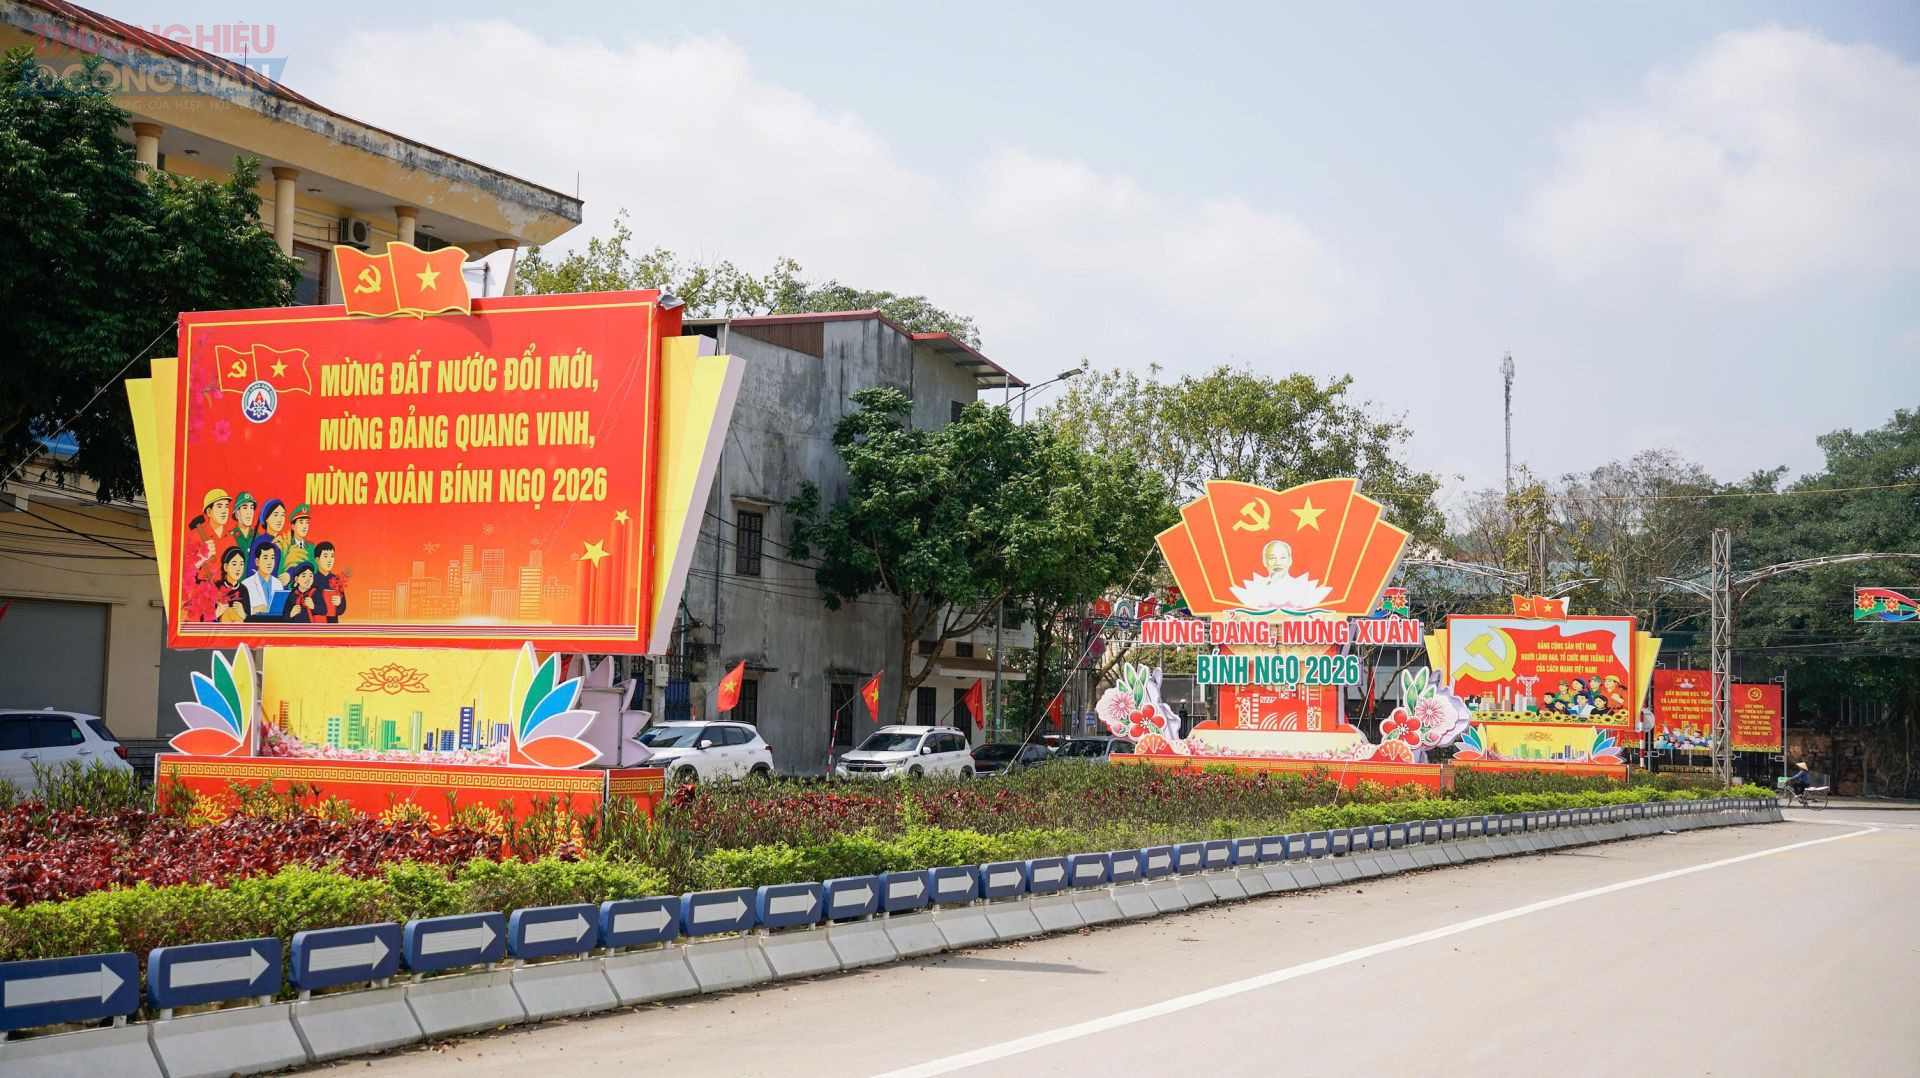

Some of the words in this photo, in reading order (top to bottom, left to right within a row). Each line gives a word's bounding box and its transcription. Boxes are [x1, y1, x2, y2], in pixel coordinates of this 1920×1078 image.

[320, 356, 384, 397] MỪNG
[390, 349, 432, 395] ĐẤT
[437, 351, 498, 393] NƯỚC
[504, 343, 542, 391] ĐỔI
[548, 347, 599, 393] MỚI,
[319, 411, 383, 451] MỪNG
[389, 404, 449, 449] ĐẢNG
[455, 412, 529, 452] QUANG
[536, 410, 596, 449] VINH,
[305, 465, 368, 505] MỪNG
[374, 463, 434, 504] XUÂN
[440, 462, 493, 503] BÍNH
[499, 467, 546, 510] NGỌ
[552, 467, 607, 502] 2026
[1141, 614, 1205, 644] MỪNG
[1210, 611, 1278, 647] ĐẢNG,
[1283, 614, 1350, 644] MỪNG
[1356, 614, 1420, 644] XUÂN
[1197, 648, 1249, 684] BÍNH
[1254, 655, 1300, 690] NGỌ
[1305, 655, 1360, 685] 2026
